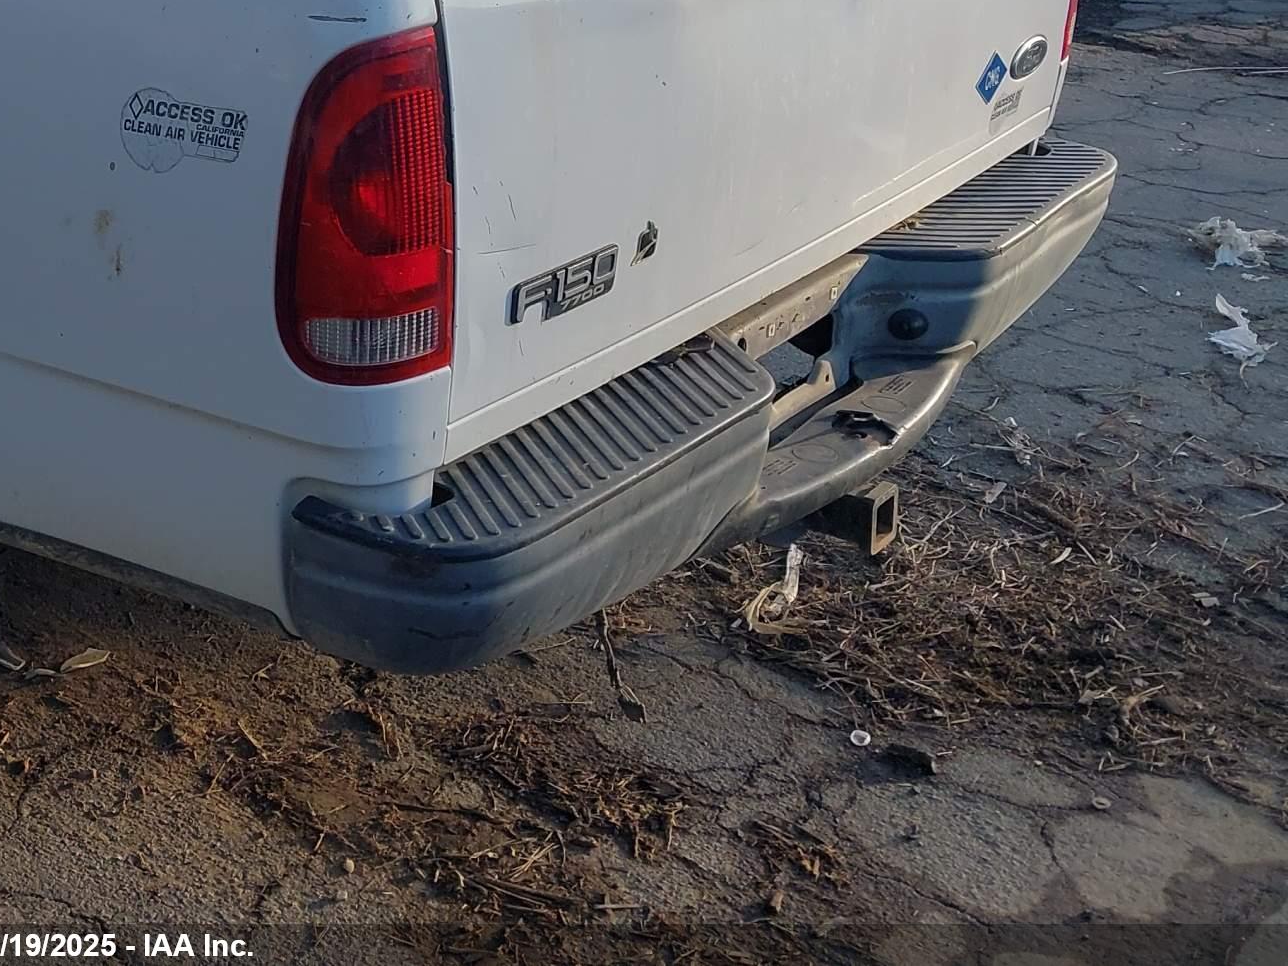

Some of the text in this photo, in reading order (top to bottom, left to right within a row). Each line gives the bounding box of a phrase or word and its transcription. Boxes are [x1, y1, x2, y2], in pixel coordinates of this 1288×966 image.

[143, 99, 248, 131] ACCESS OK
[124, 119, 241, 151] CLEAN AIR VEHICLE
[196, 123, 245, 138] CALIFORNIA
[560, 283, 605, 311] 7700
